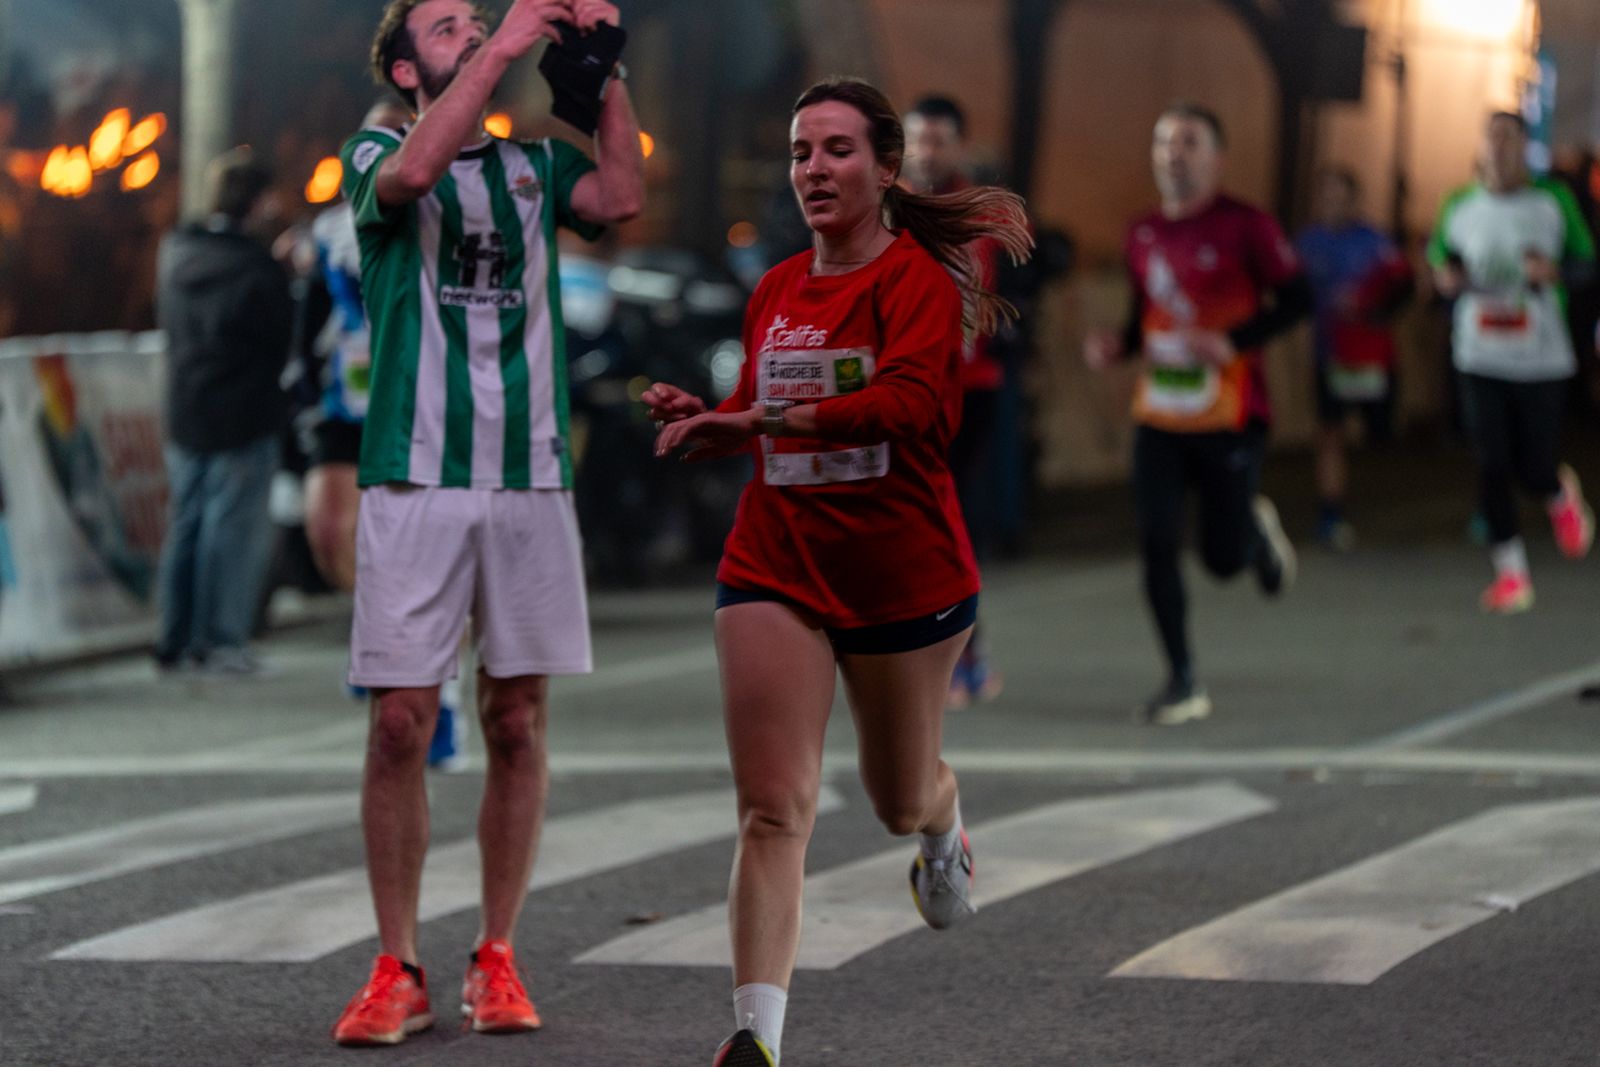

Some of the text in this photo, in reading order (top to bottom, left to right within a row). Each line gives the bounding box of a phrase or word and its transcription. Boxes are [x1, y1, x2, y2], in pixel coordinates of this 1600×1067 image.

[441, 288, 521, 305] network
[779, 366, 824, 379] NOCHE DE
[768, 384, 785, 396] SAN
